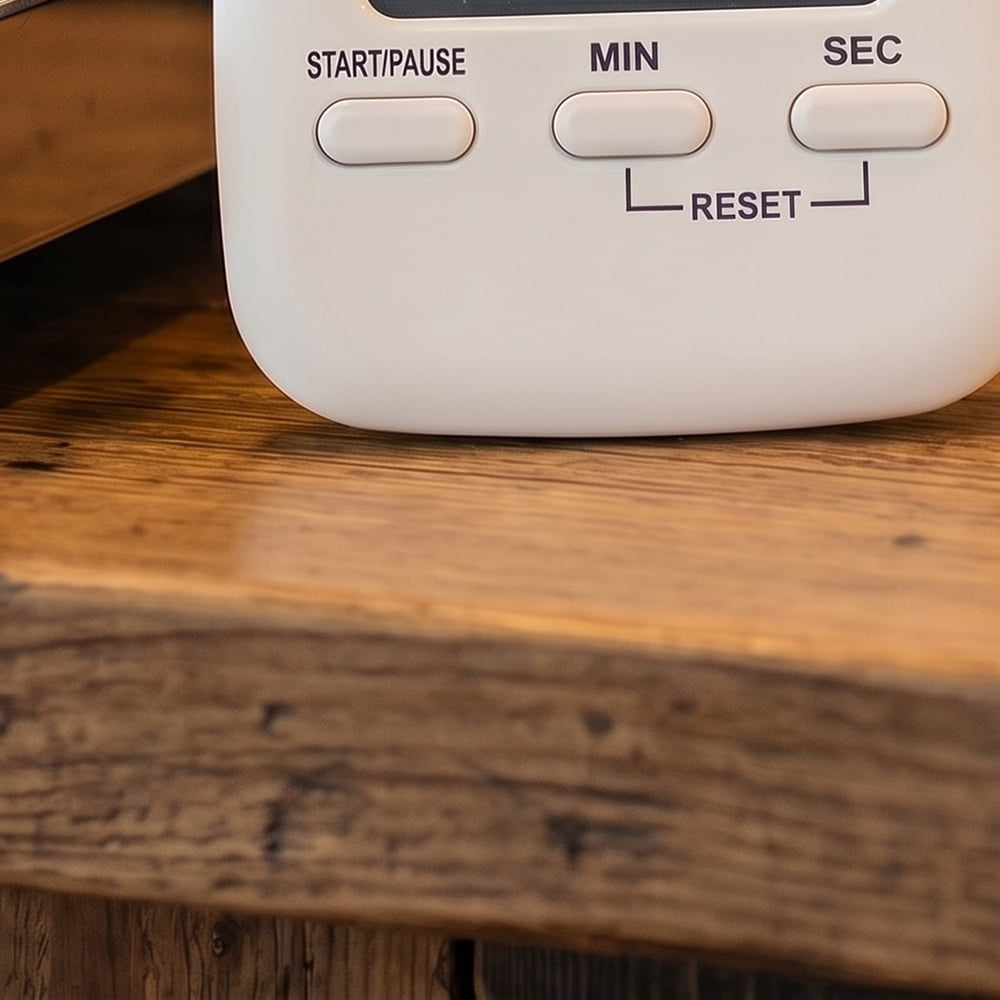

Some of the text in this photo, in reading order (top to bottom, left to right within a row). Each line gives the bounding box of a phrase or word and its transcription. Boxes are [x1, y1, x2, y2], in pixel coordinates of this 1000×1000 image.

[307, 47, 466, 80] START/PAUSE
[590, 41, 659, 72] MIN
[823, 34, 903, 66] SEC
[691, 190, 802, 221] RESET
